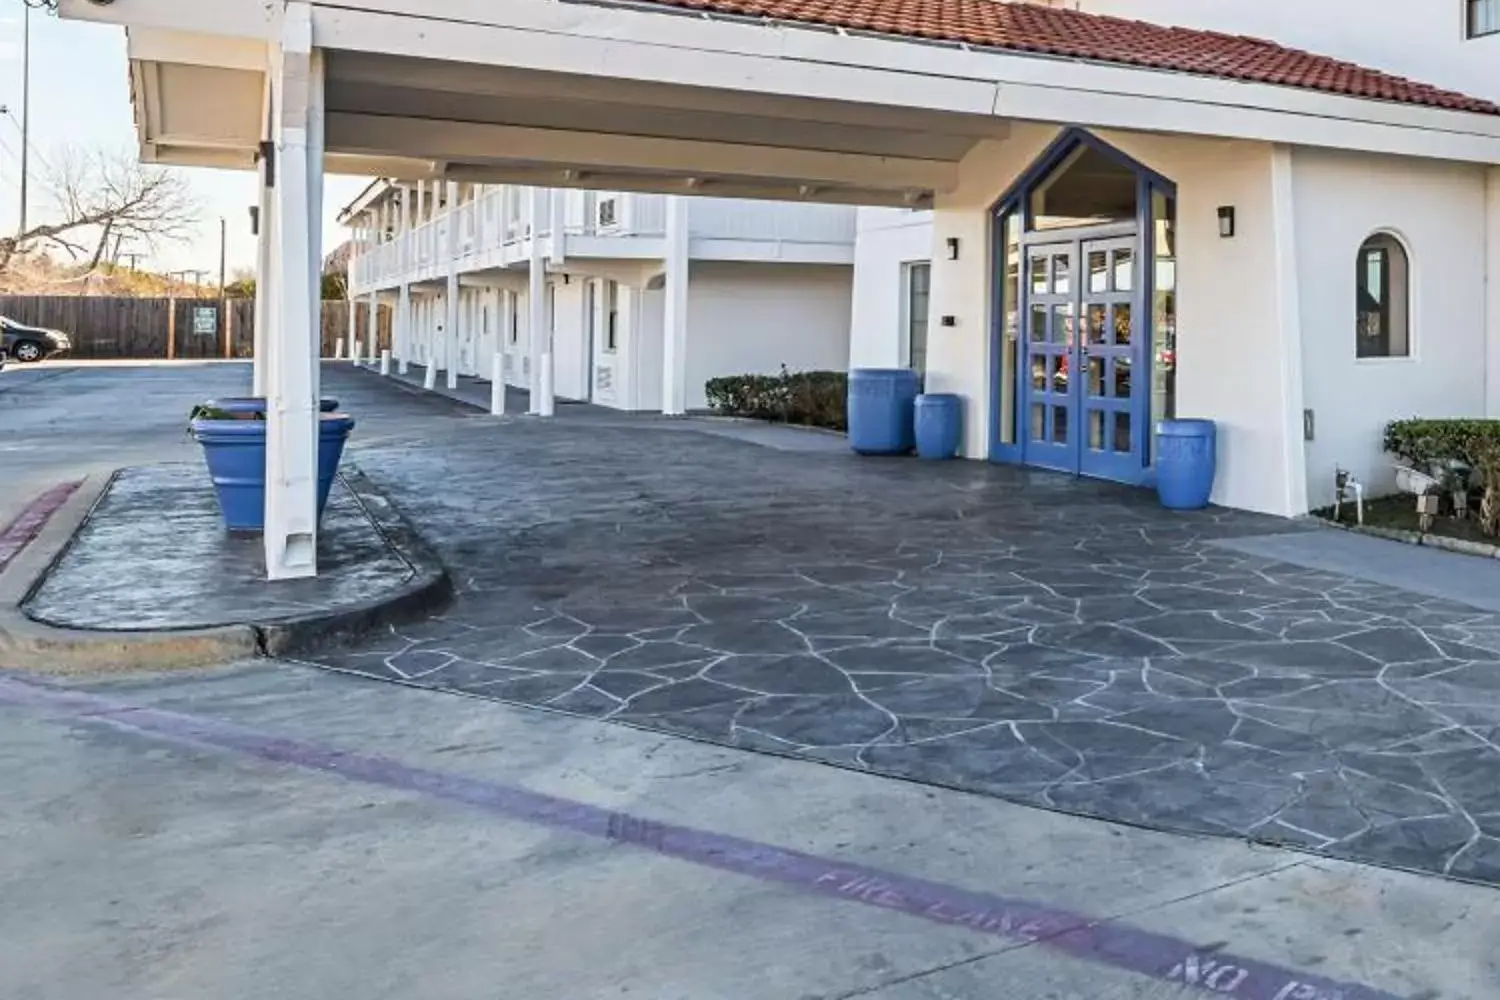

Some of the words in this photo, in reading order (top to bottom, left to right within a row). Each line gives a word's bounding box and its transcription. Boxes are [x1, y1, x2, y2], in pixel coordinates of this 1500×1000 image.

[813, 872, 902, 904] FIRE
[923, 900, 1042, 942] LANE
[1166, 955, 1249, 992] NO
